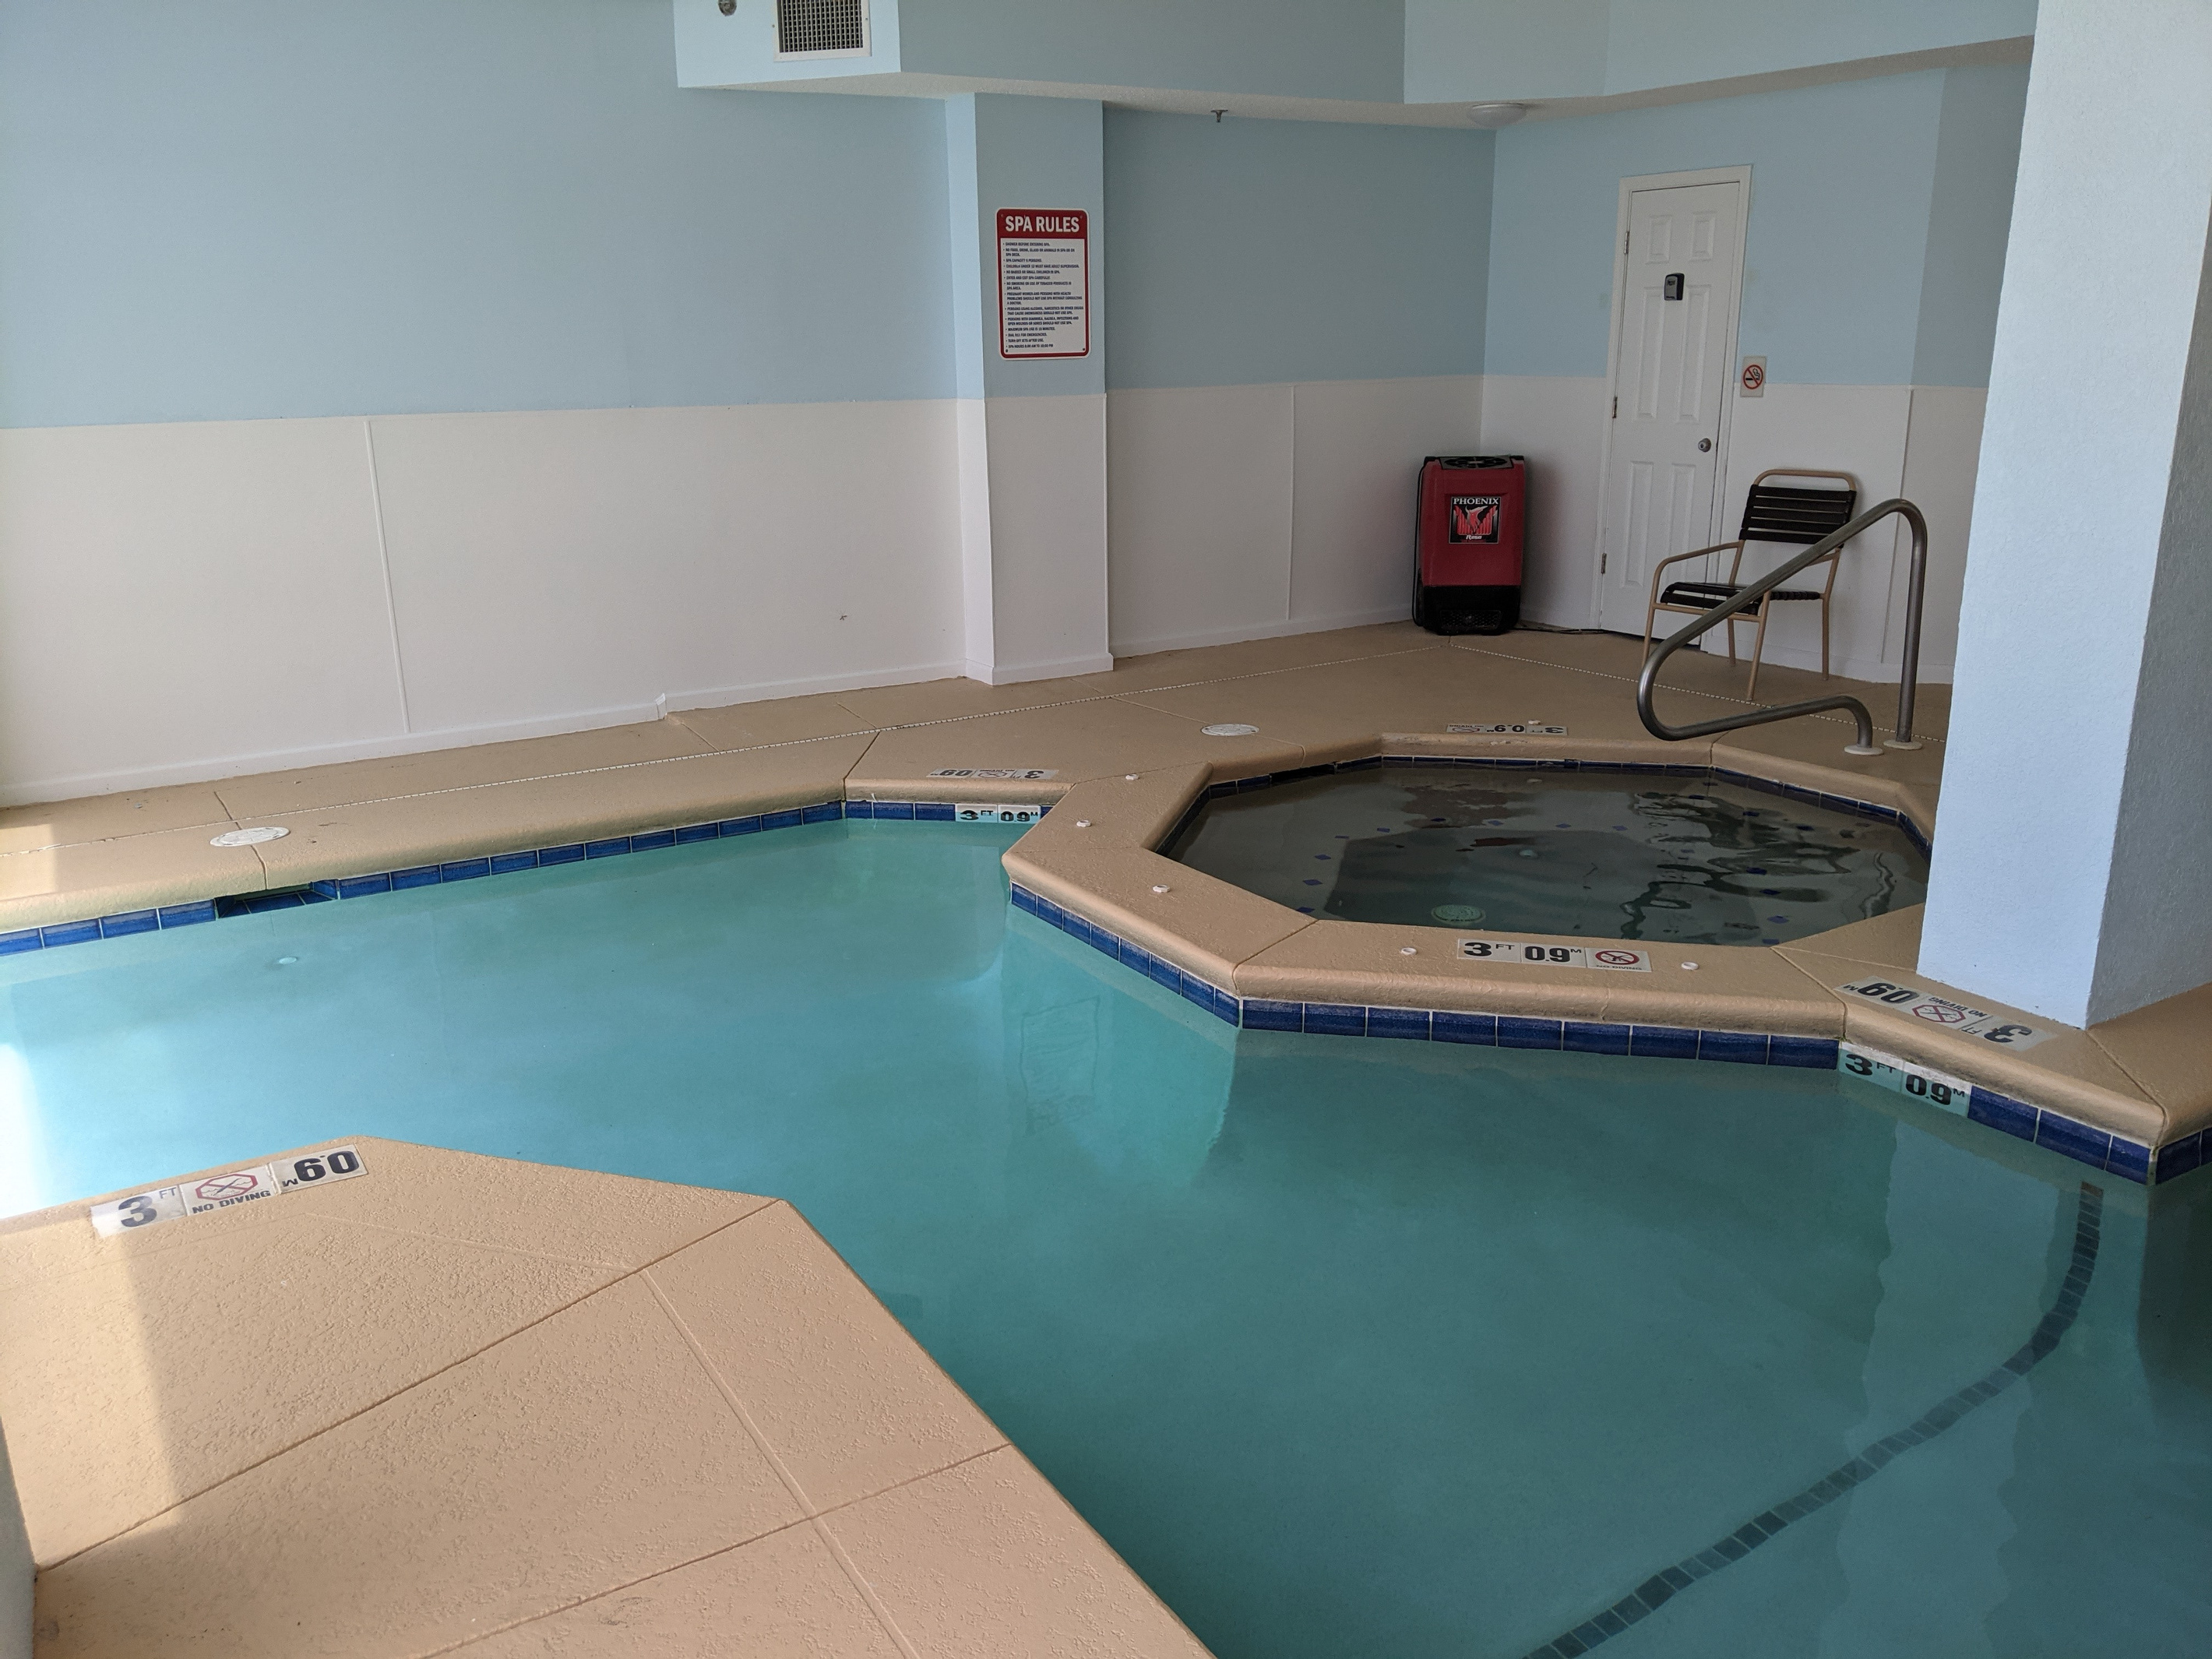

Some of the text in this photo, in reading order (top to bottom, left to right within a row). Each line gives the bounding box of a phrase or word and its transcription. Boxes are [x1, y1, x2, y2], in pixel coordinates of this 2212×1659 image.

[1006, 216, 1079, 232] SPA RULES
[960, 810, 979, 820] 3
[1464, 942, 1492, 956] 3
[1928, 997, 1967, 1011] DIVING
[1961, 1024, 2032, 1043] 3 FT
[1846, 1054, 1872, 1076] 3
[1877, 1062, 1897, 1073] FT
[118, 1187, 177, 1228] 3 FT
[192, 1189, 271, 1213] NO DIVING
